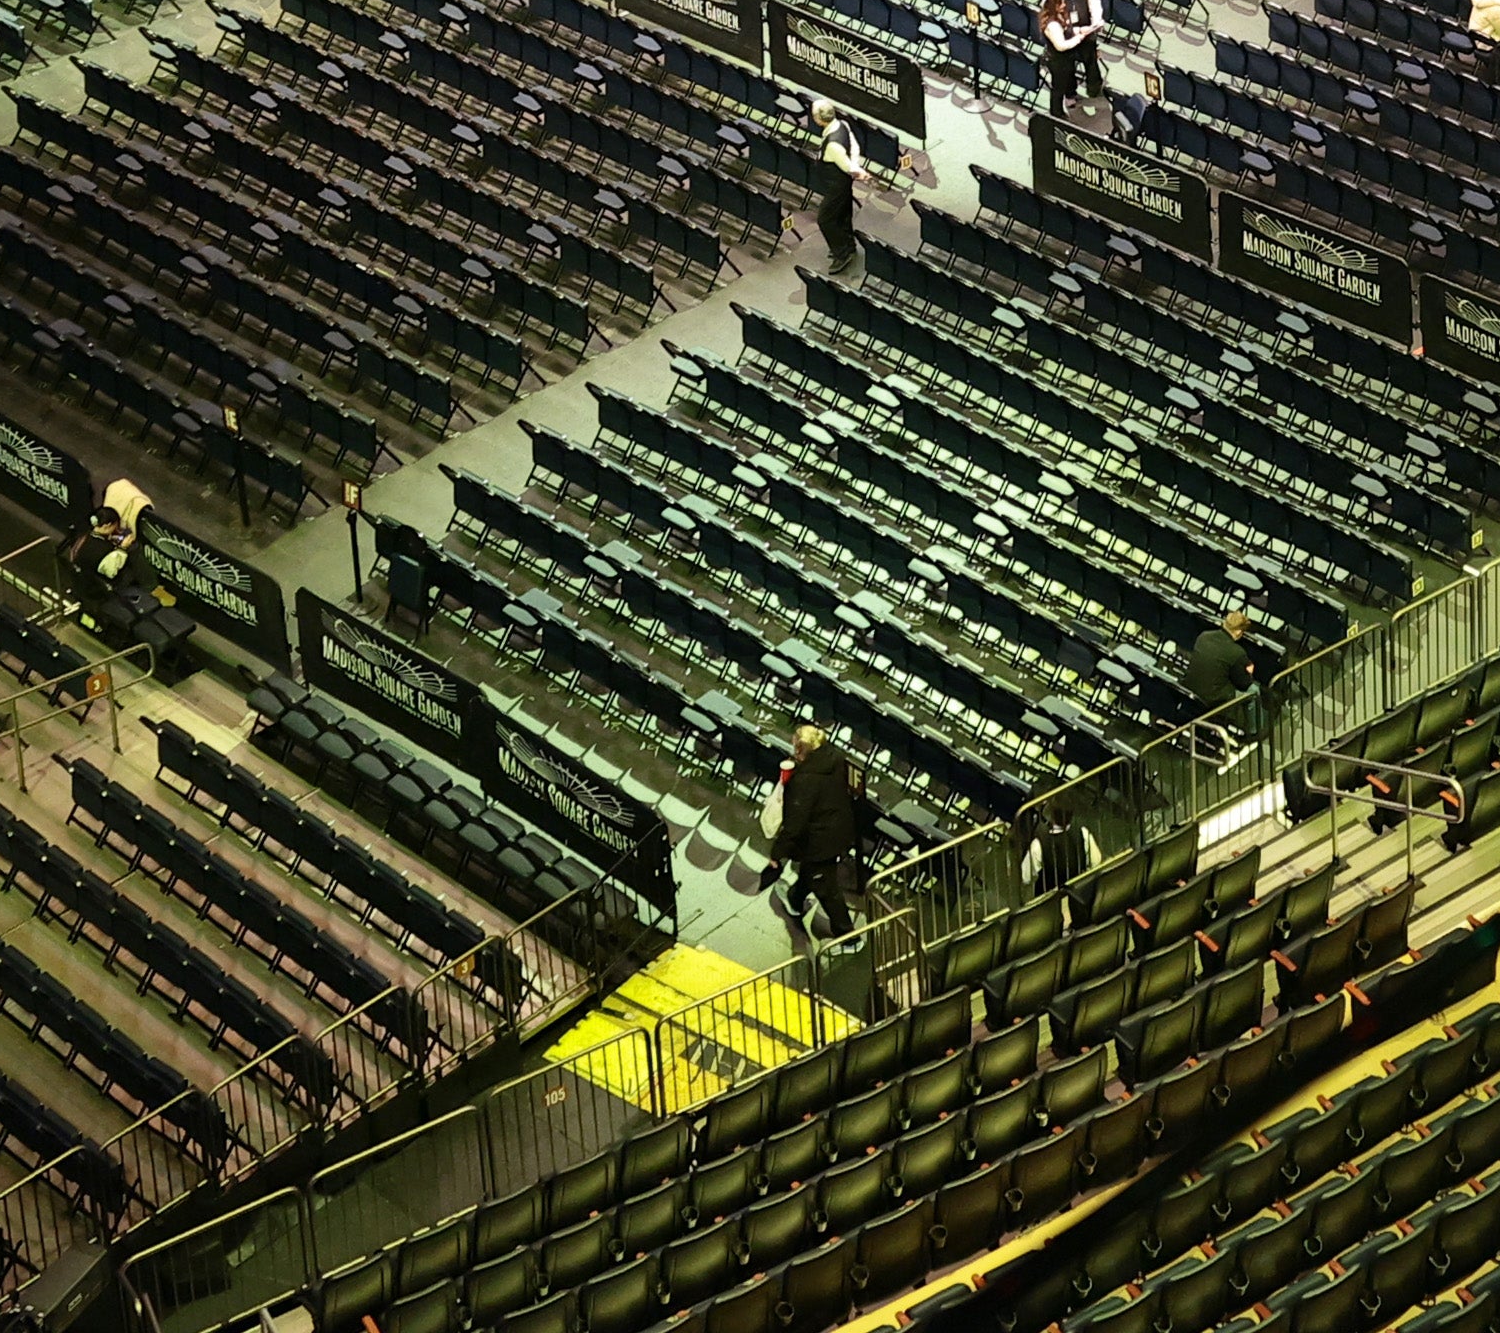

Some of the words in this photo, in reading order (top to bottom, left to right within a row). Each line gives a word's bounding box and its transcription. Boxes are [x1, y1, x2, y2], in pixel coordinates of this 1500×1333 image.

[704, 0, 742, 31] GARDEN
[786, 34, 828, 68] MADISON
[828, 51, 863, 83] SQUARE
[863, 66, 900, 101] GARDEN
[1054, 149, 1100, 185] MADISON
[1102, 172, 1141, 202] SQUARE
[1141, 186, 1182, 219] GARDEN
[1242, 230, 1292, 266] MADISON
[1293, 253, 1336, 285] SQUARE
[1337, 267, 1382, 303] GARDEN
[1444, 315, 1496, 353] MADISON
[345, 481, 360, 506] 1F
[175, 560, 215, 600] SQUARE
[214, 583, 258, 623] GARDEN
[322, 635, 373, 675] MADISON
[373, 665, 416, 709] SQUARE
[417, 691, 461, 735] GARDEN
[498, 746, 545, 794] MADISON
[546, 783, 591, 831] SQUARE
[847, 763, 863, 789] 1F
[461, 961, 469, 975] 3
[545, 1086, 567, 1107] 105
